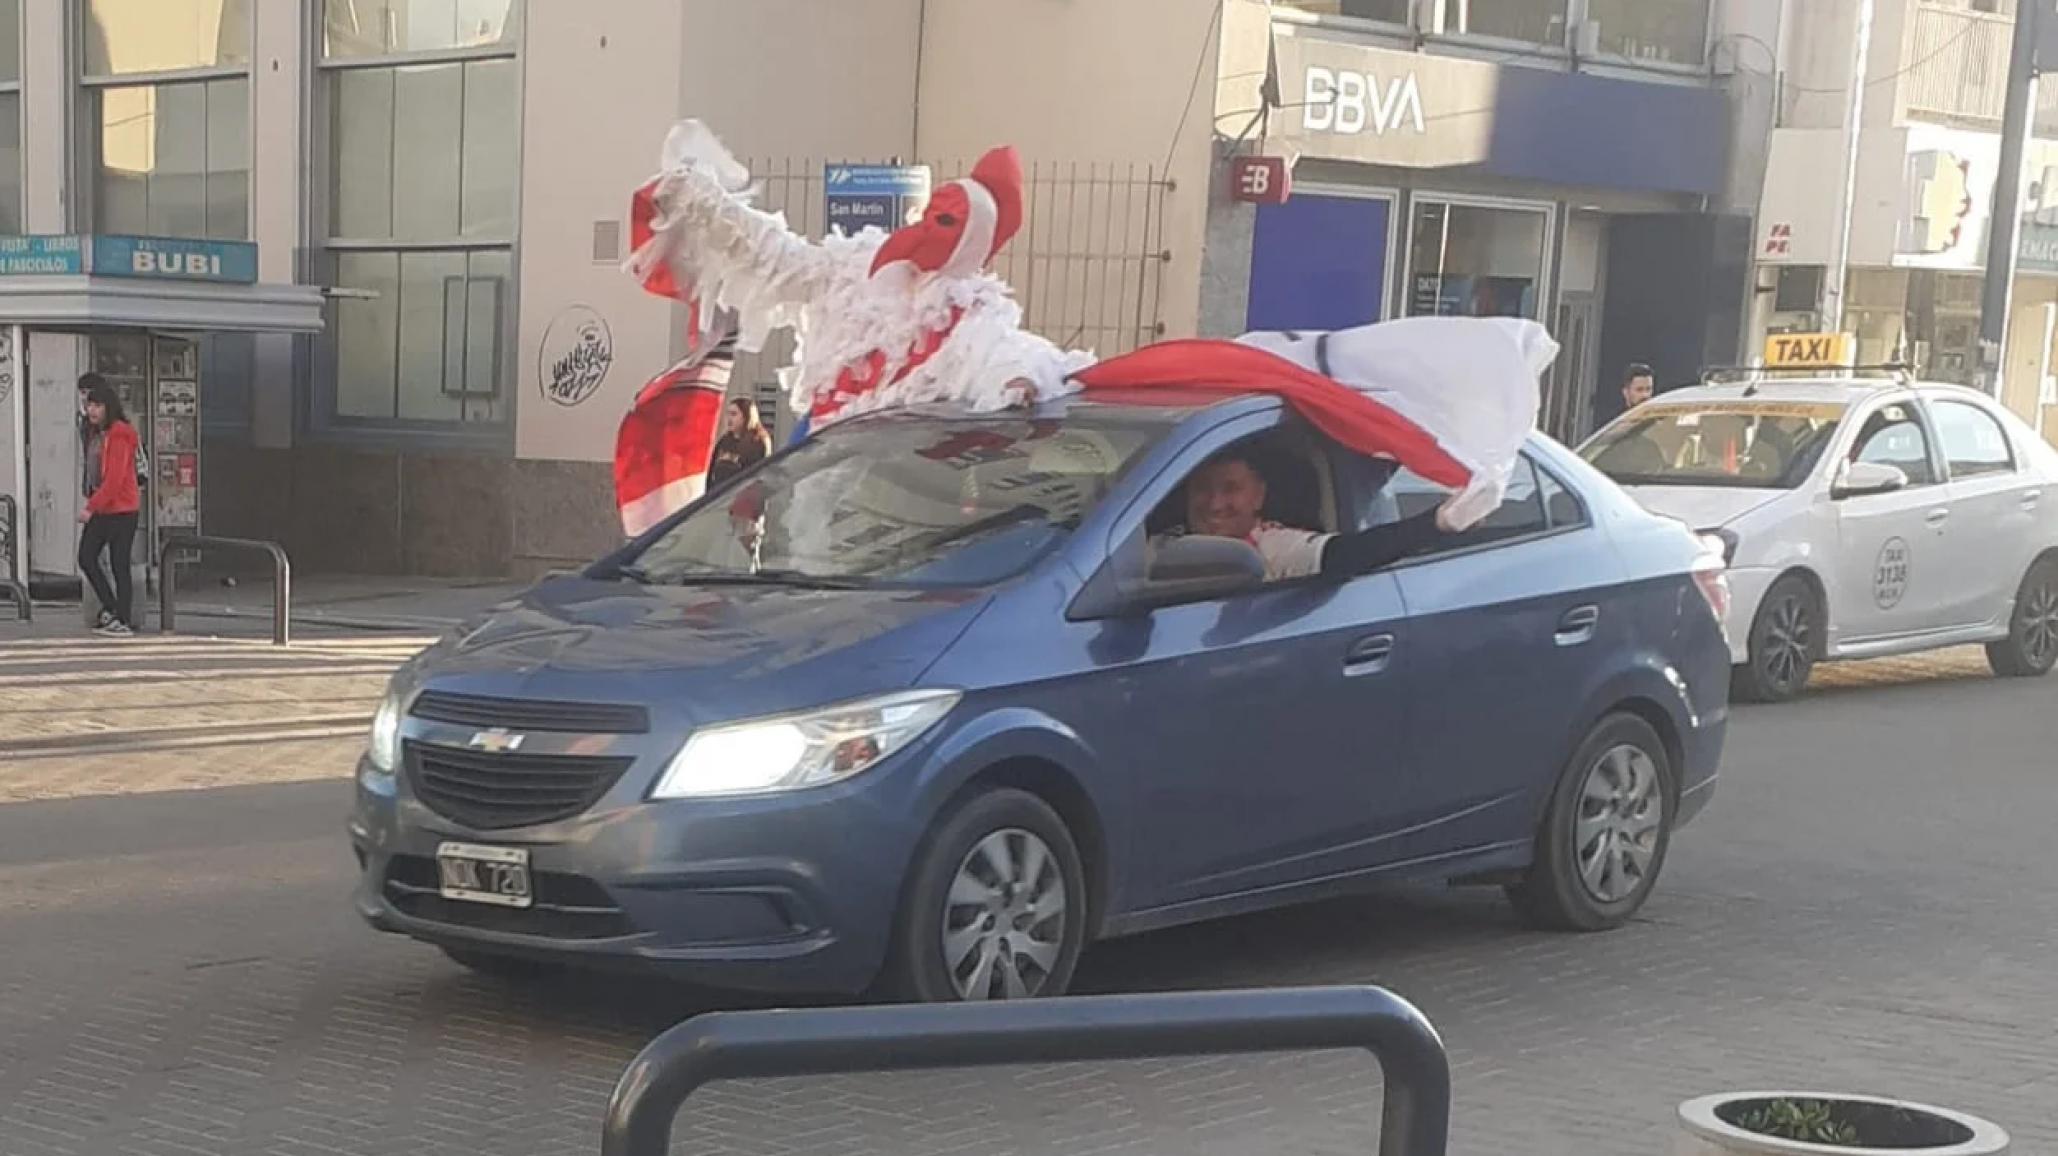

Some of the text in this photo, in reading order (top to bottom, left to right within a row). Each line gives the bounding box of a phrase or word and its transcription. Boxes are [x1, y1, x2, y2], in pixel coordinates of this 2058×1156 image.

[1302, 65, 1426, 136] BBVA
[829, 202, 850, 216] San
[133, 250, 220, 274] BUBI
[1775, 338, 1831, 361] TAXI
